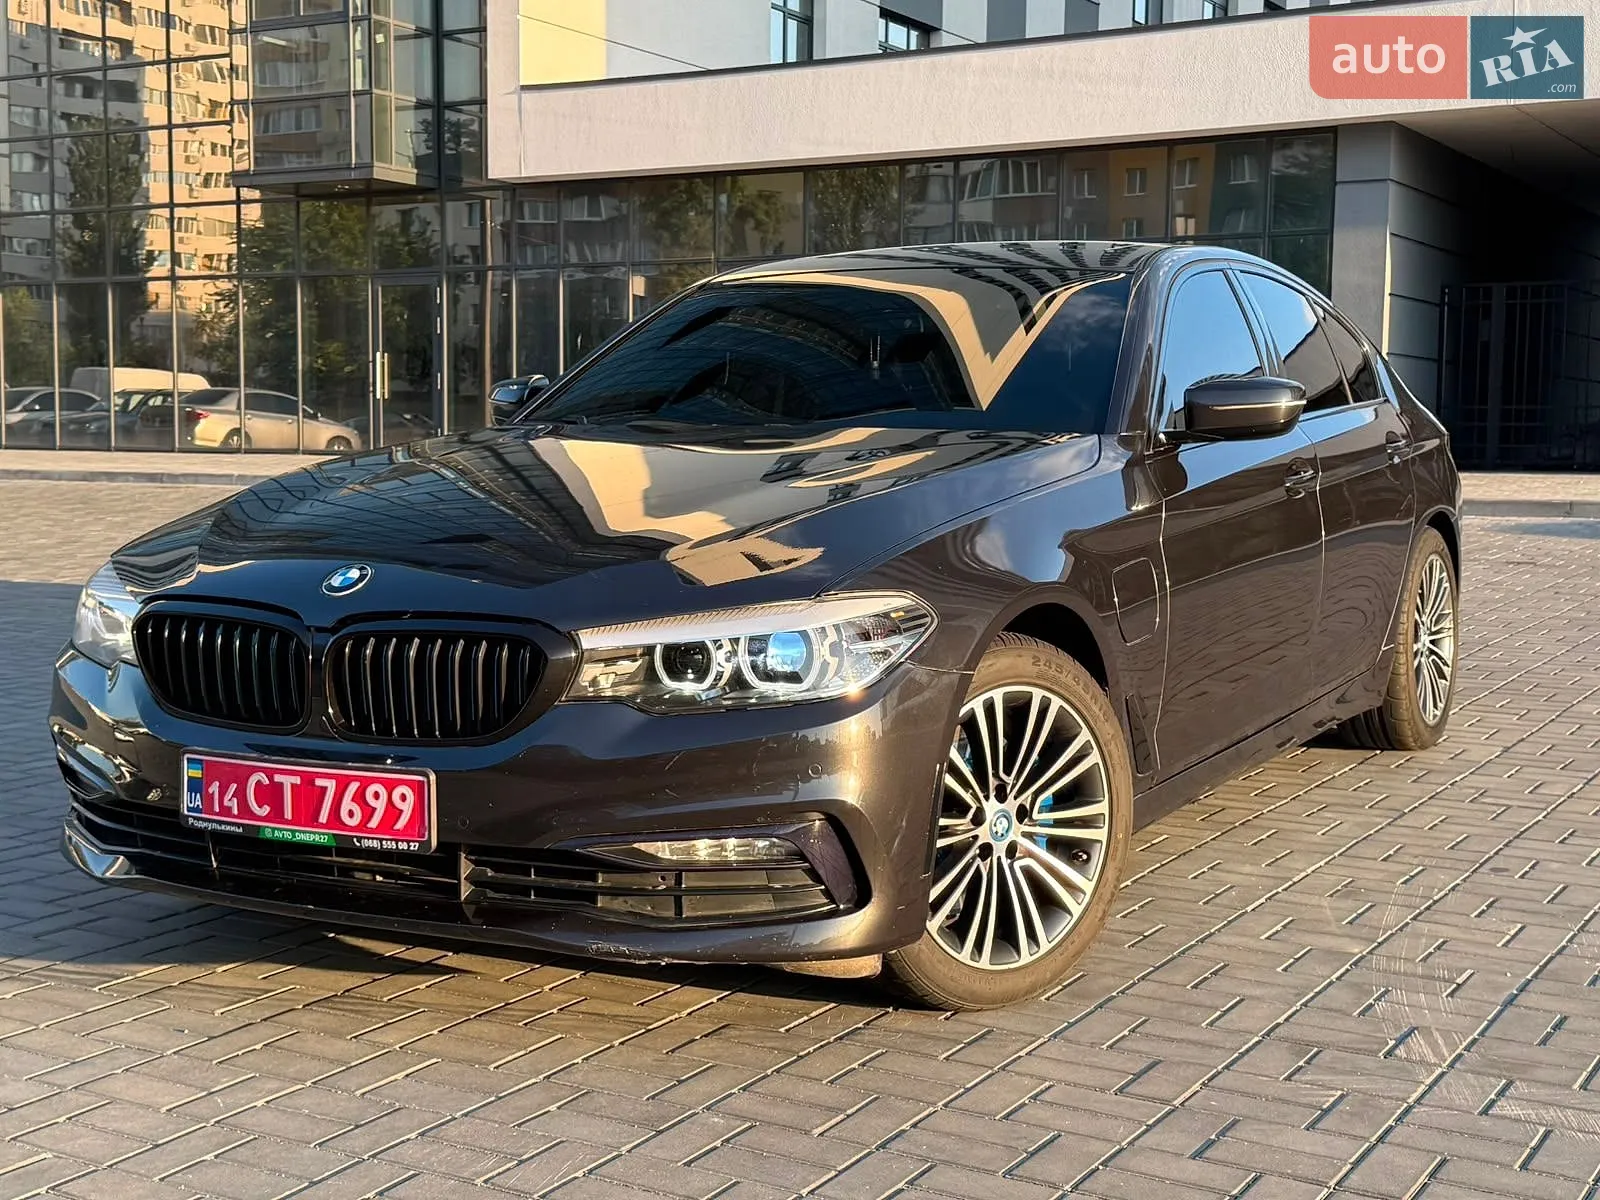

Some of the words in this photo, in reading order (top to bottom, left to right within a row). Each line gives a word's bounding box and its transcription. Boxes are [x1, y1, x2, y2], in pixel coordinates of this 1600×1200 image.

[187, 791, 203, 809] UA
[208, 781, 238, 815] 14
[246, 771, 301, 821] CT
[314, 778, 415, 831] 7699
[409, 842, 419, 851] 27
